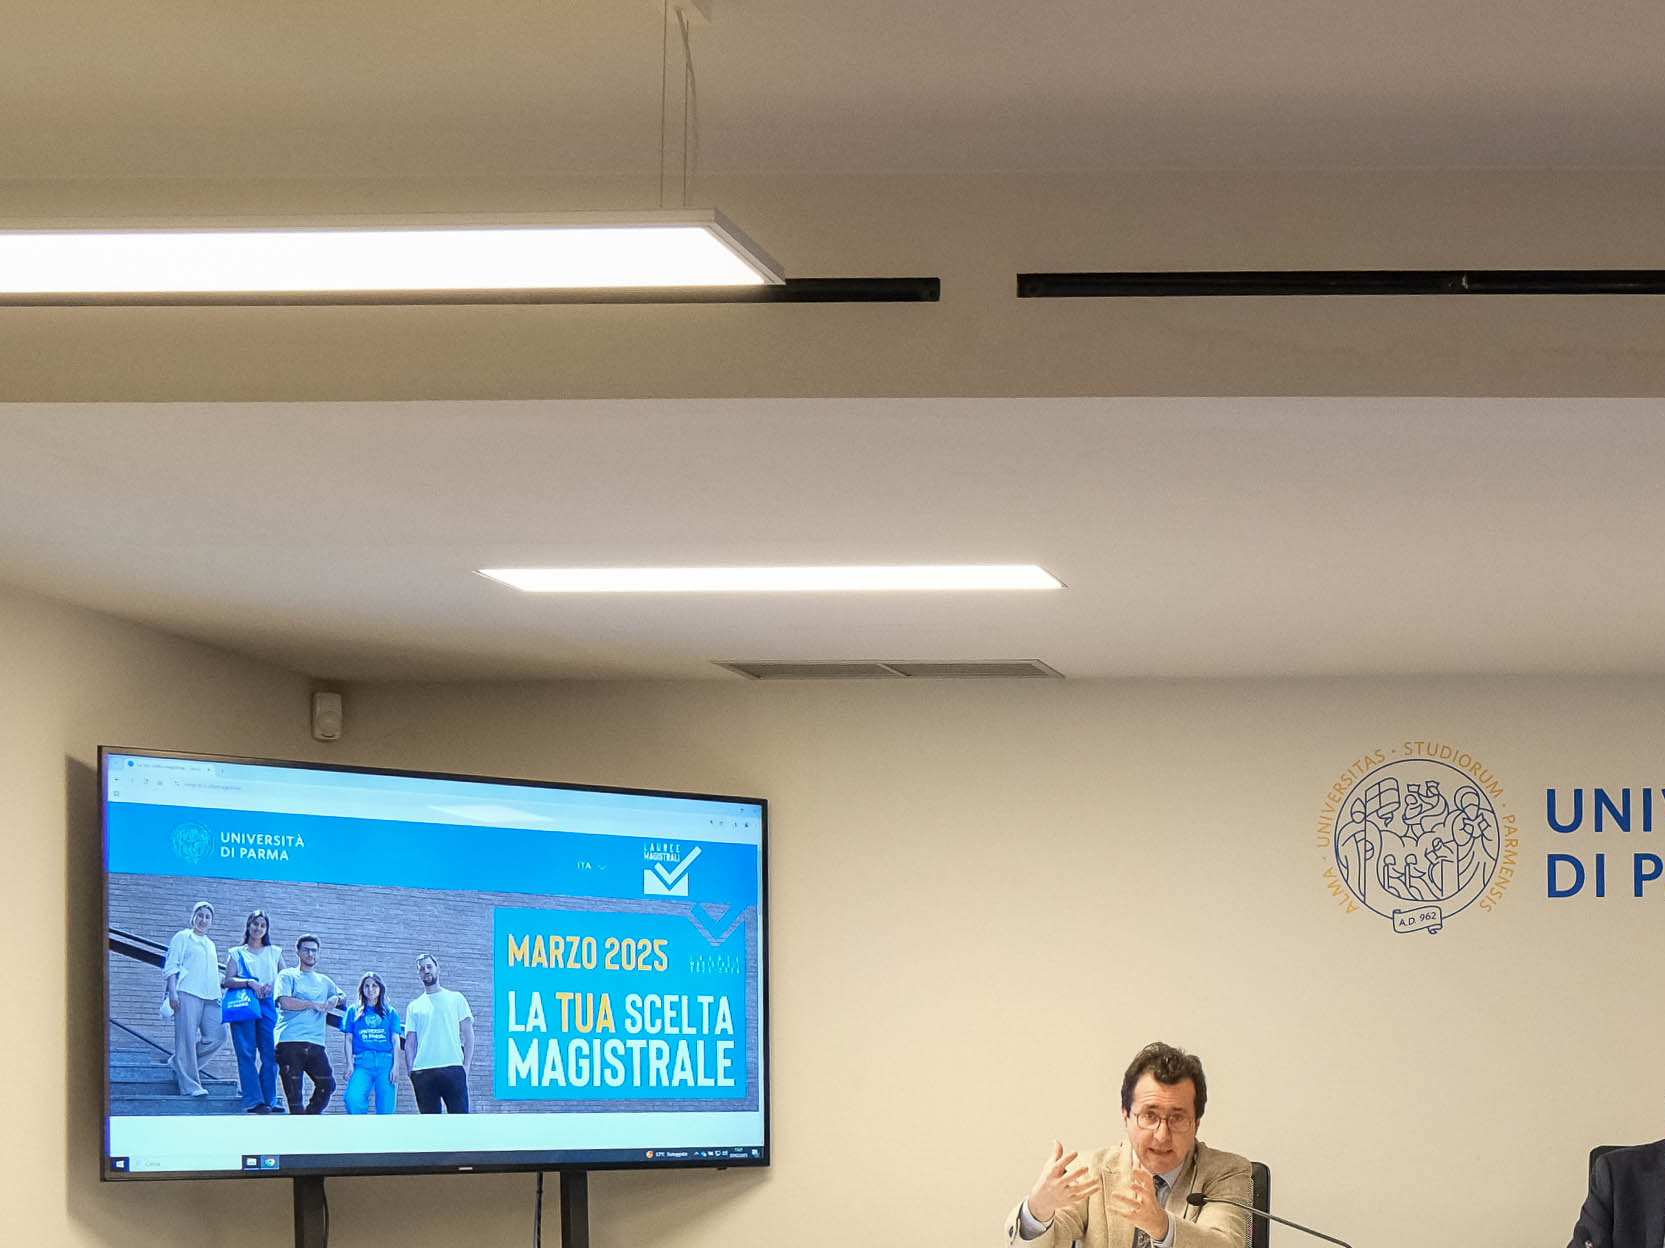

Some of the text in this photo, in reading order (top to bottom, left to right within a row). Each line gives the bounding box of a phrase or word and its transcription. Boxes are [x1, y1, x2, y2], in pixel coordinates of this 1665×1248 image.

[220, 831, 305, 848] UNIVERSITÀ
[1316, 741, 1520, 913] ALMA UNIVERSITAS STUDIORUM PARMENSIS
[220, 846, 289, 861] DI PARMA
[1547, 852, 1606, 898] DI
[1399, 911, 1437, 927] A.D. 962
[507, 933, 598, 970] MARZO
[604, 937, 669, 972] 2025
[507, 990, 735, 1035] LA TUA SCELTA
[507, 1037, 736, 1087] MAGISTRALE
